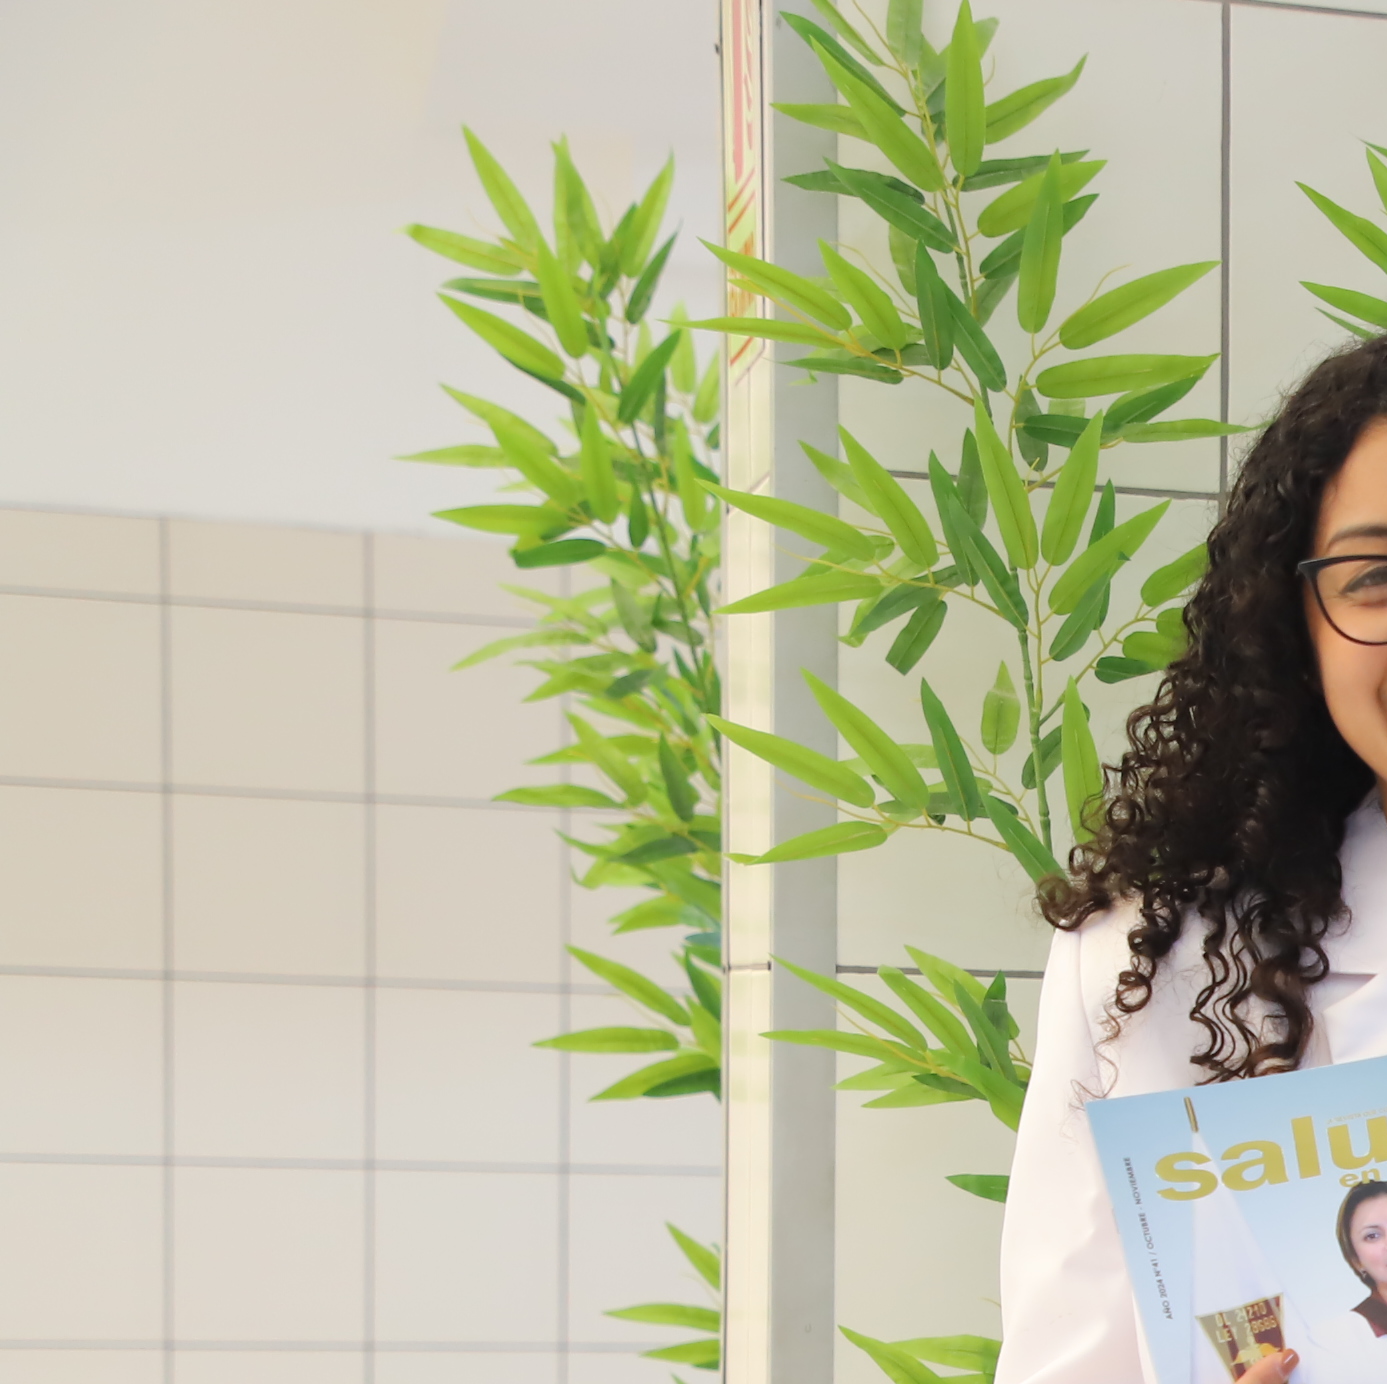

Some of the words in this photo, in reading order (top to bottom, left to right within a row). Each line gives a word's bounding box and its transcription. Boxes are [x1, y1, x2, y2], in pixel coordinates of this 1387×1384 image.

[1123, 1157, 1142, 1205] NOVIEMBRE
[1339, 1167, 1381, 1188] en
[1139, 1213, 1154, 1250] OCTUBRE
[1156, 1278, 1168, 1298] 2024
[1162, 1301, 1173, 1320] AÑO
[1215, 1312, 1231, 1327] DL
[1216, 1327, 1238, 1343] LEY
